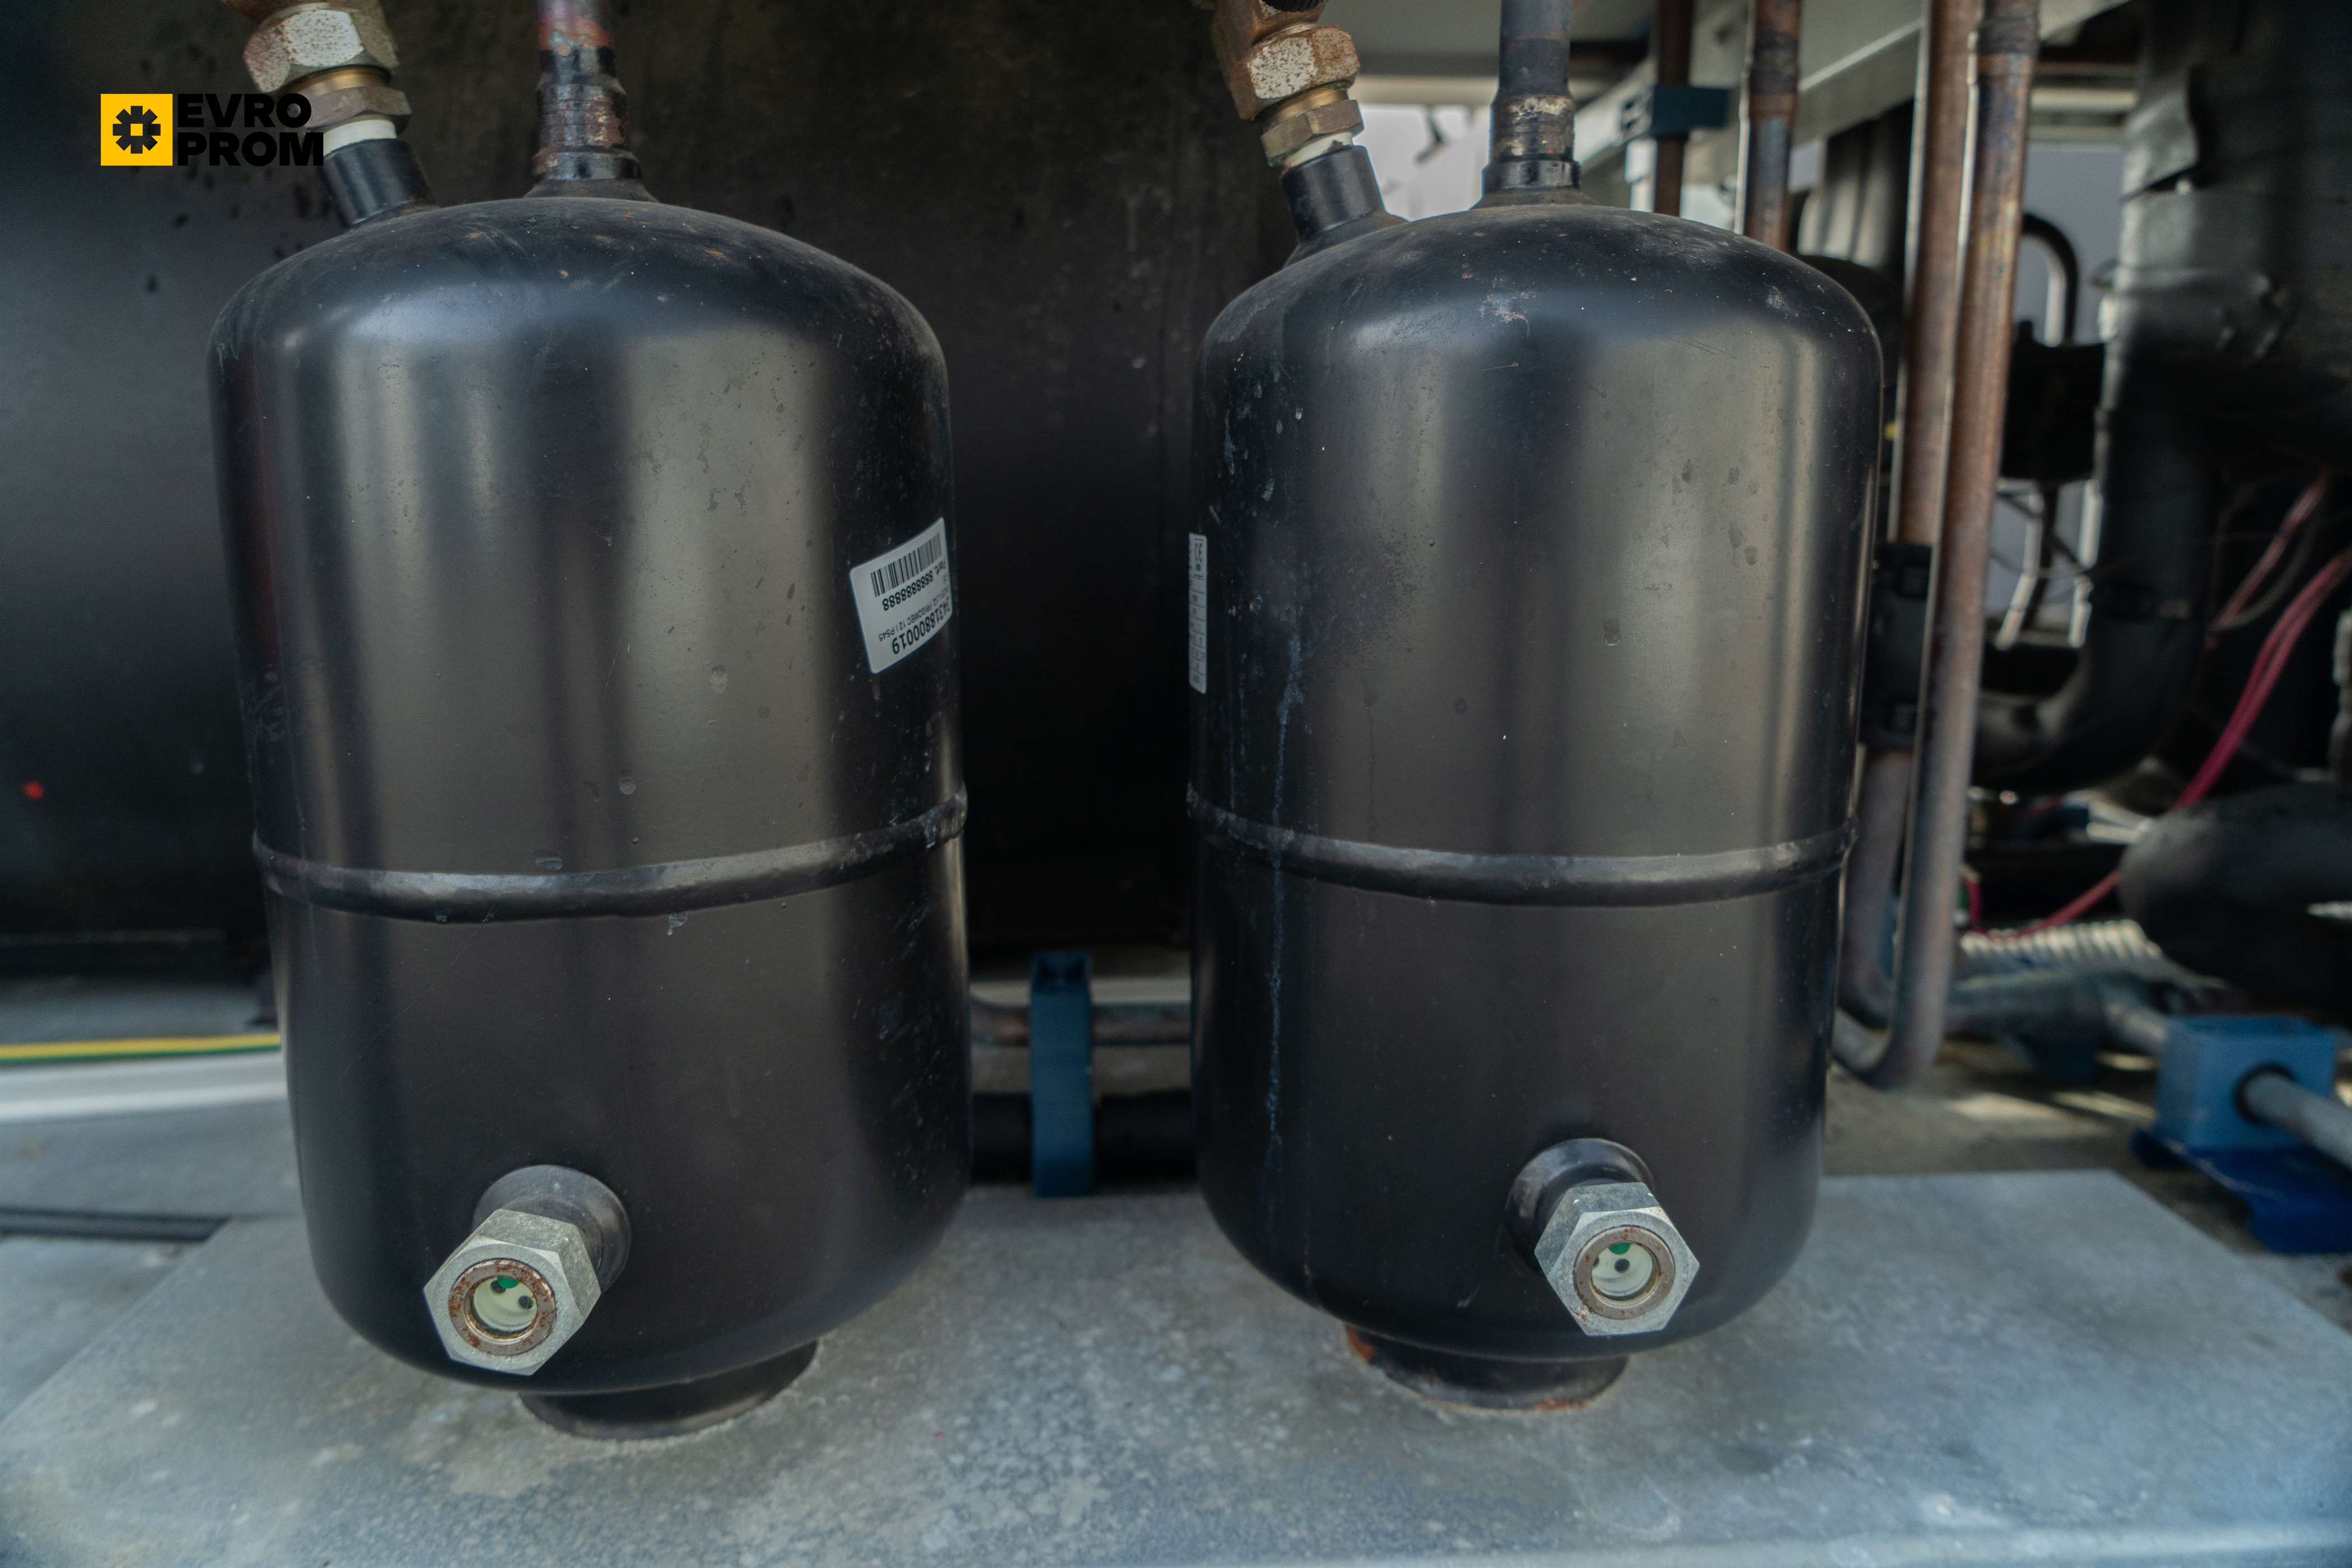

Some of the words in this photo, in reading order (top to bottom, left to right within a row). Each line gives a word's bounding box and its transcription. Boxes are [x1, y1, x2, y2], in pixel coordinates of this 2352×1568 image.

[882, 570, 934, 611] 8888888888
[899, 620, 908, 631] 12
[879, 626, 895, 642] PS45
